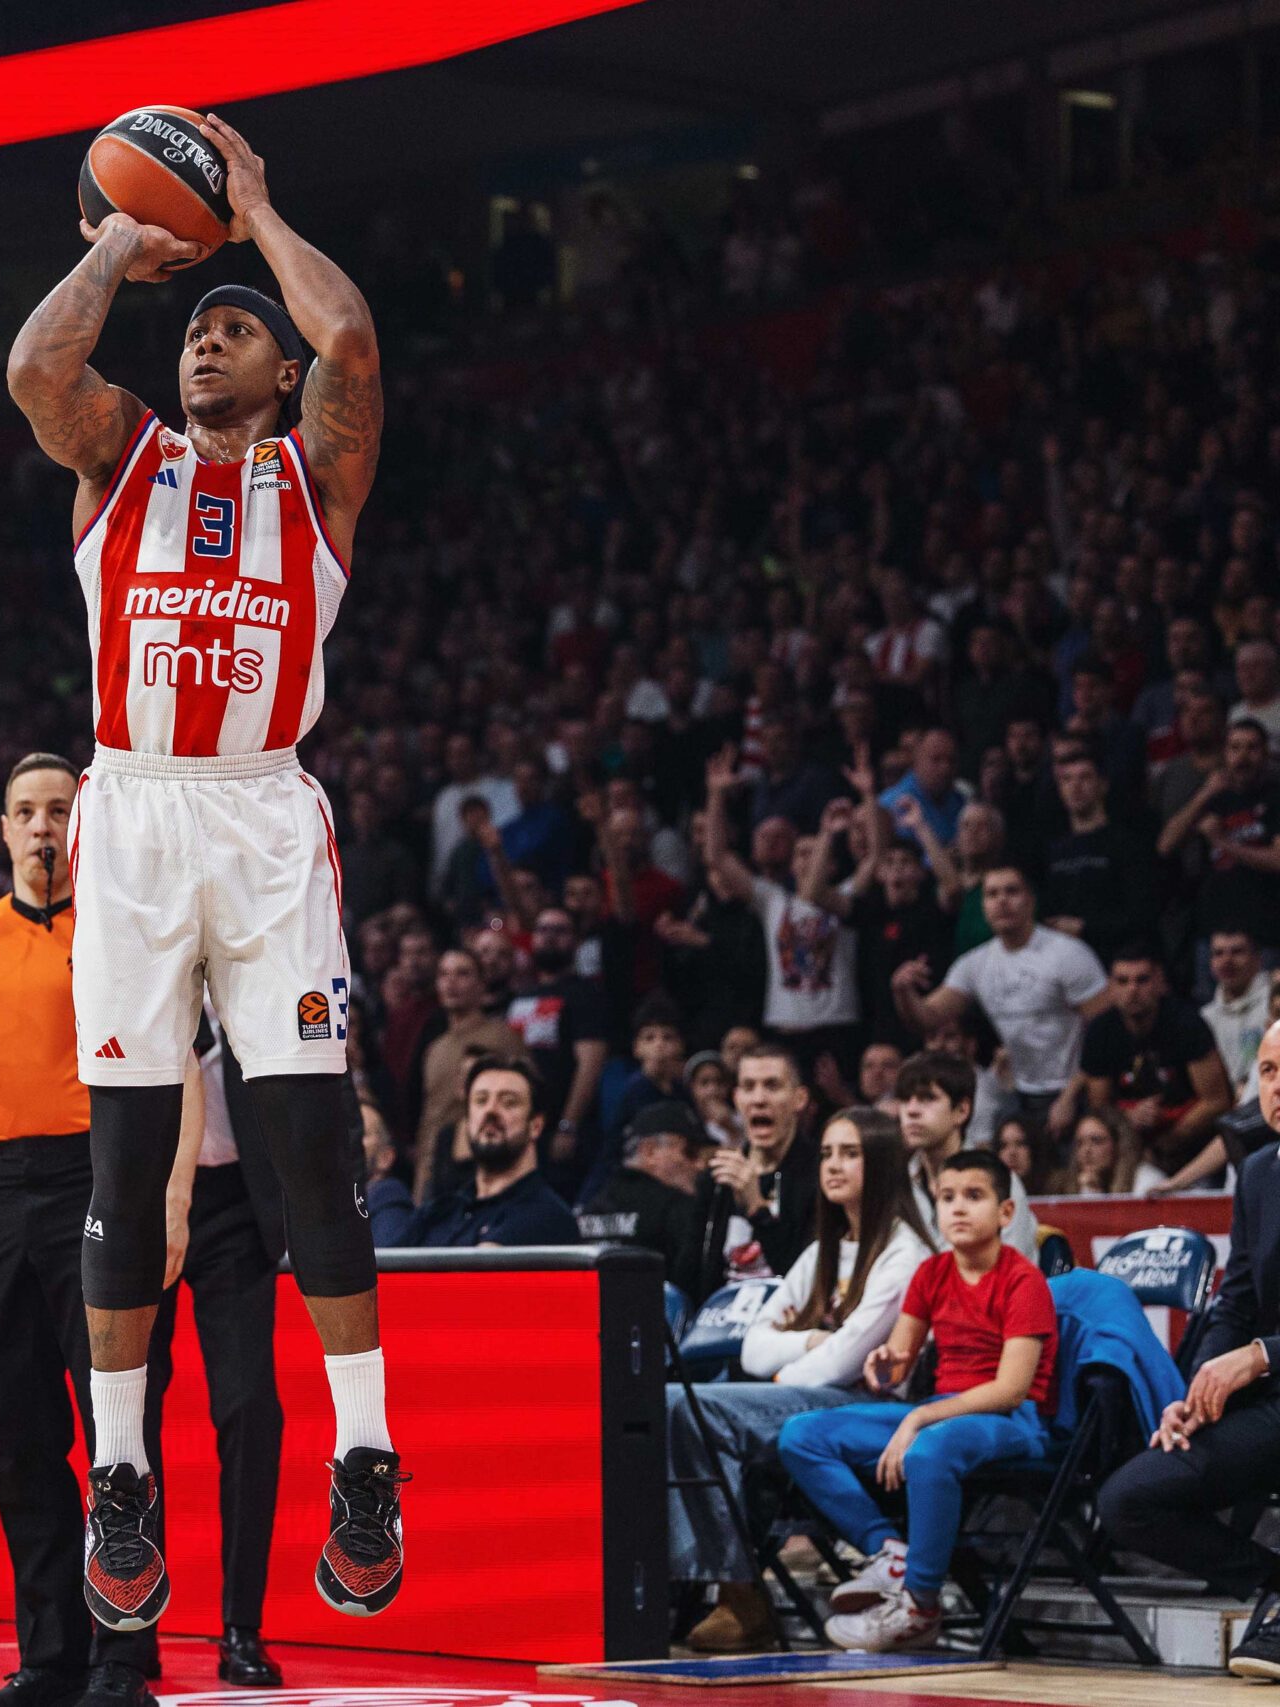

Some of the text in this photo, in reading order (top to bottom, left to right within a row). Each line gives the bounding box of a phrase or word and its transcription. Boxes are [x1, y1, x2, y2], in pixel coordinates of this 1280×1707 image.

[193, 492, 235, 558] 3
[124, 579, 290, 626] meridian
[144, 638, 263, 693] mts
